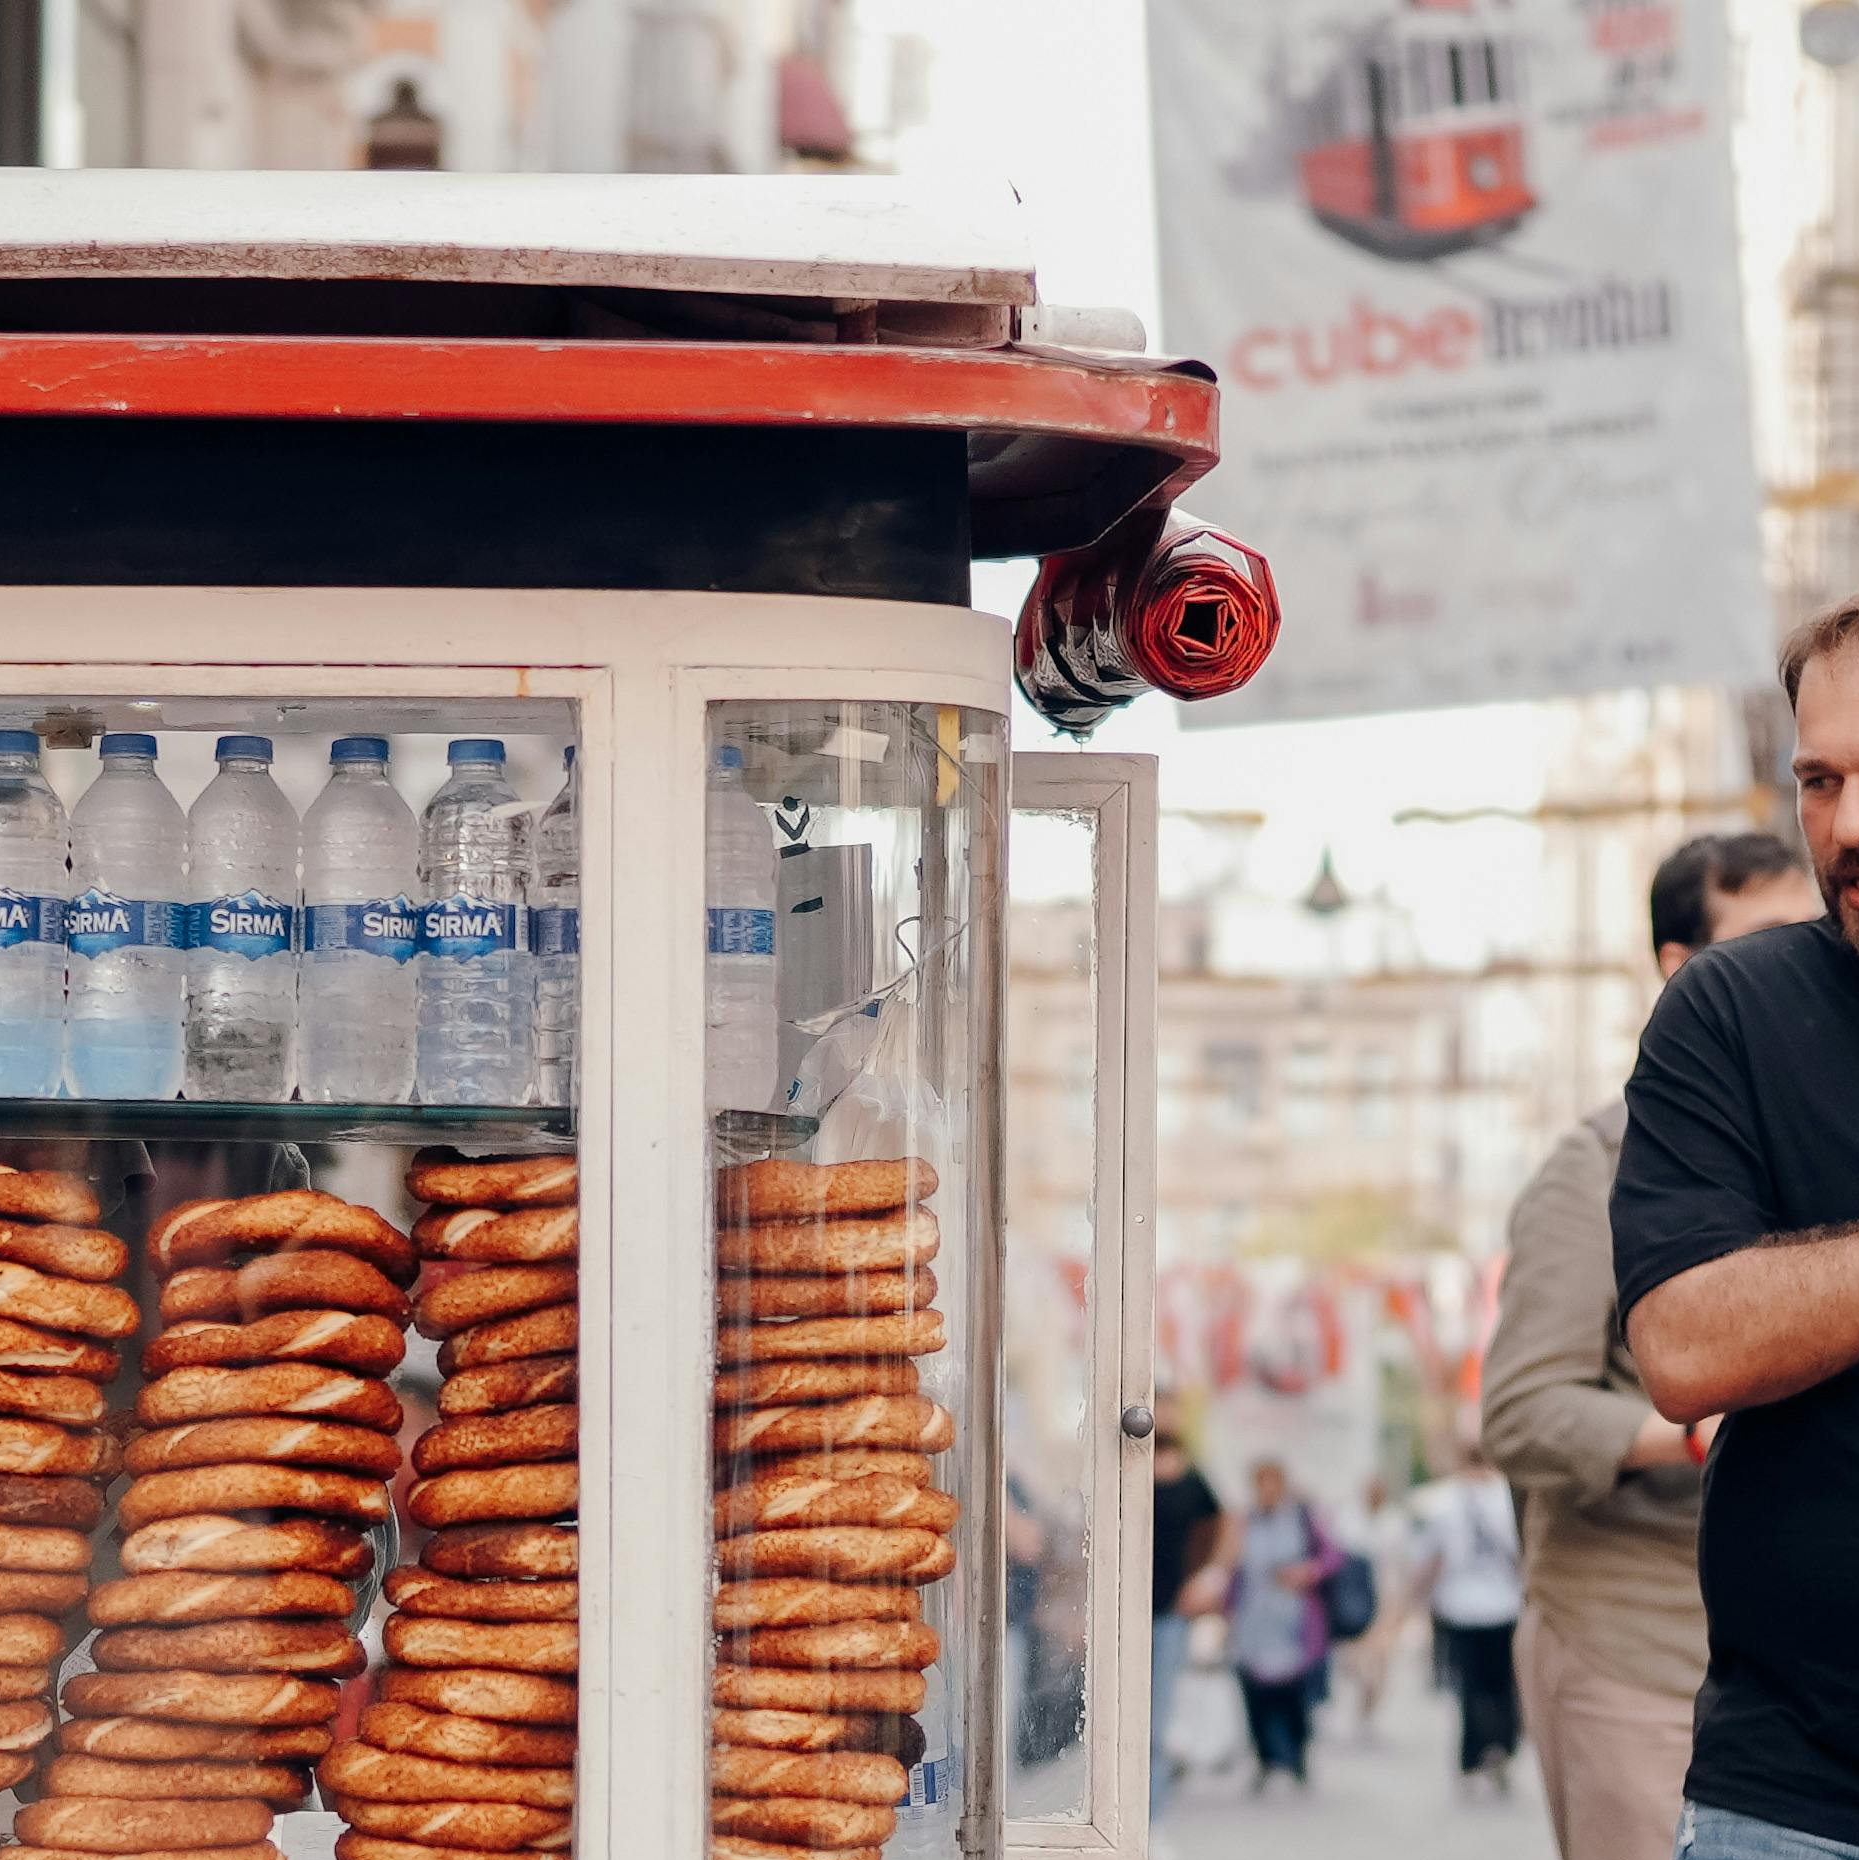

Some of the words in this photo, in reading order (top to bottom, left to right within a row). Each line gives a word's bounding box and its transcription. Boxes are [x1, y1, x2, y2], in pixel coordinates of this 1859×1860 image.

[210, 908, 285, 936] SIRMA
[362, 912, 418, 939] SIRM
[426, 912, 503, 937] SIRMA
